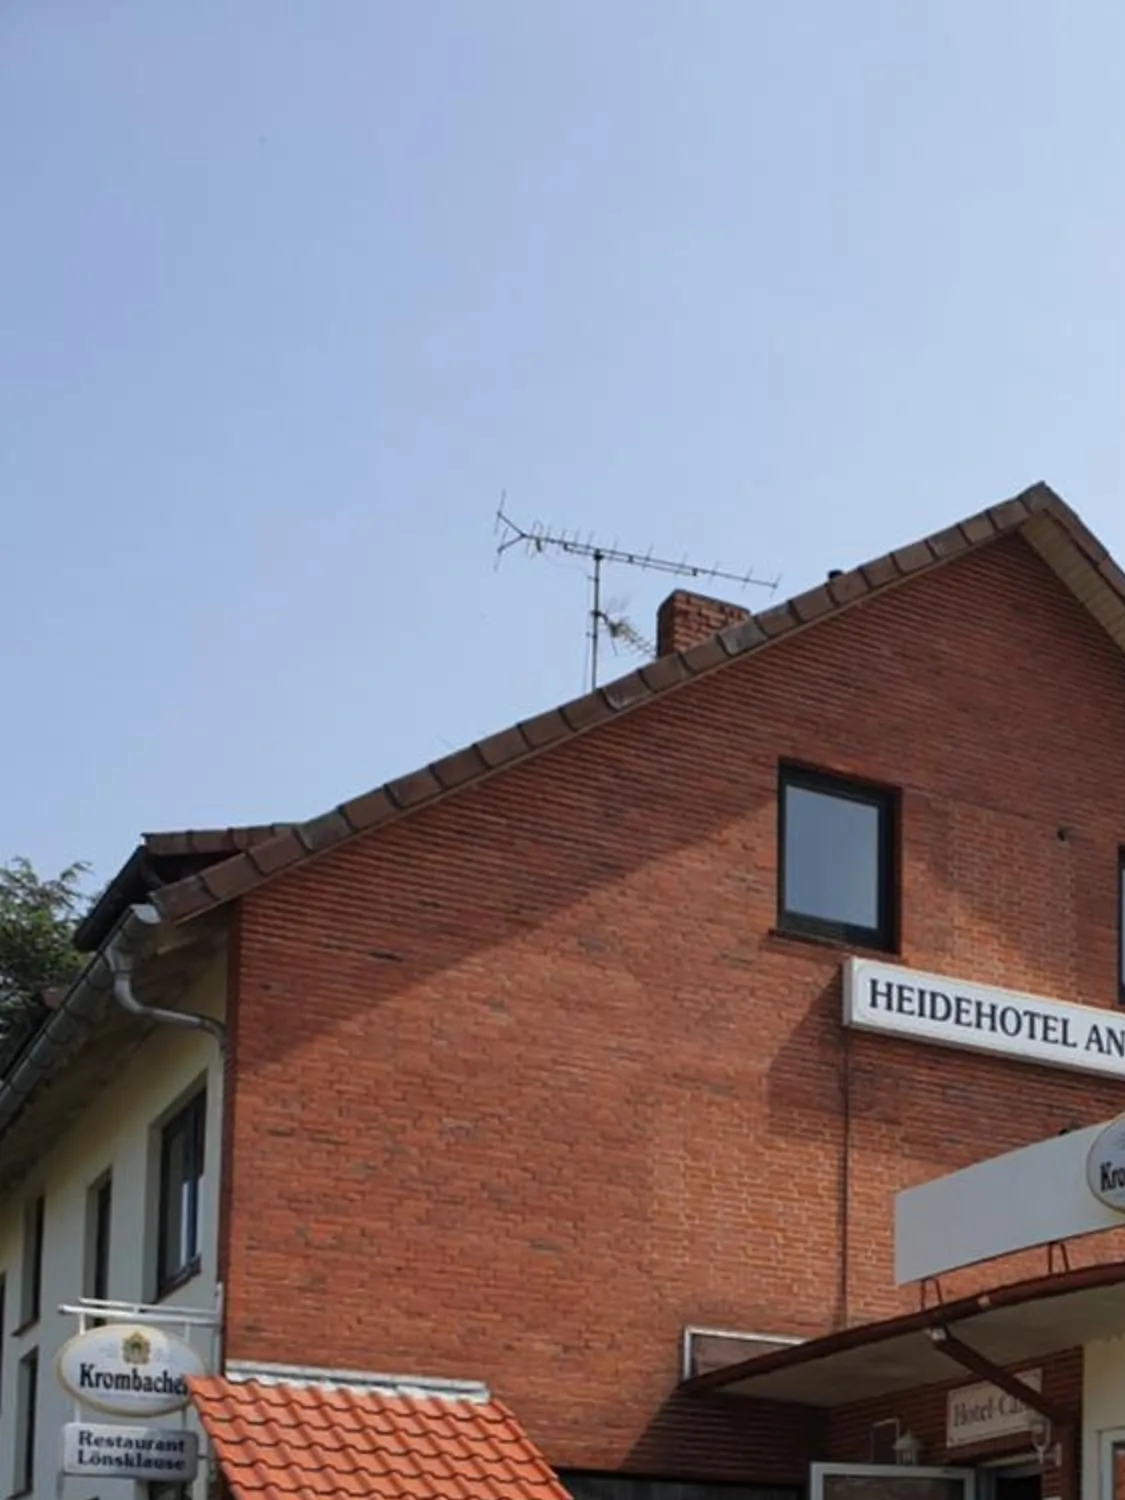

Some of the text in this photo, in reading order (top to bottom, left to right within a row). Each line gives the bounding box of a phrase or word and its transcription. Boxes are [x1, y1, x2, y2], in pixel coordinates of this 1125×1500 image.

[868, 978, 1077, 1047] HEIDEHOTEL
[78, 1429, 185, 1453] Restaurant
[77, 1450, 187, 1471] Lönsklause
